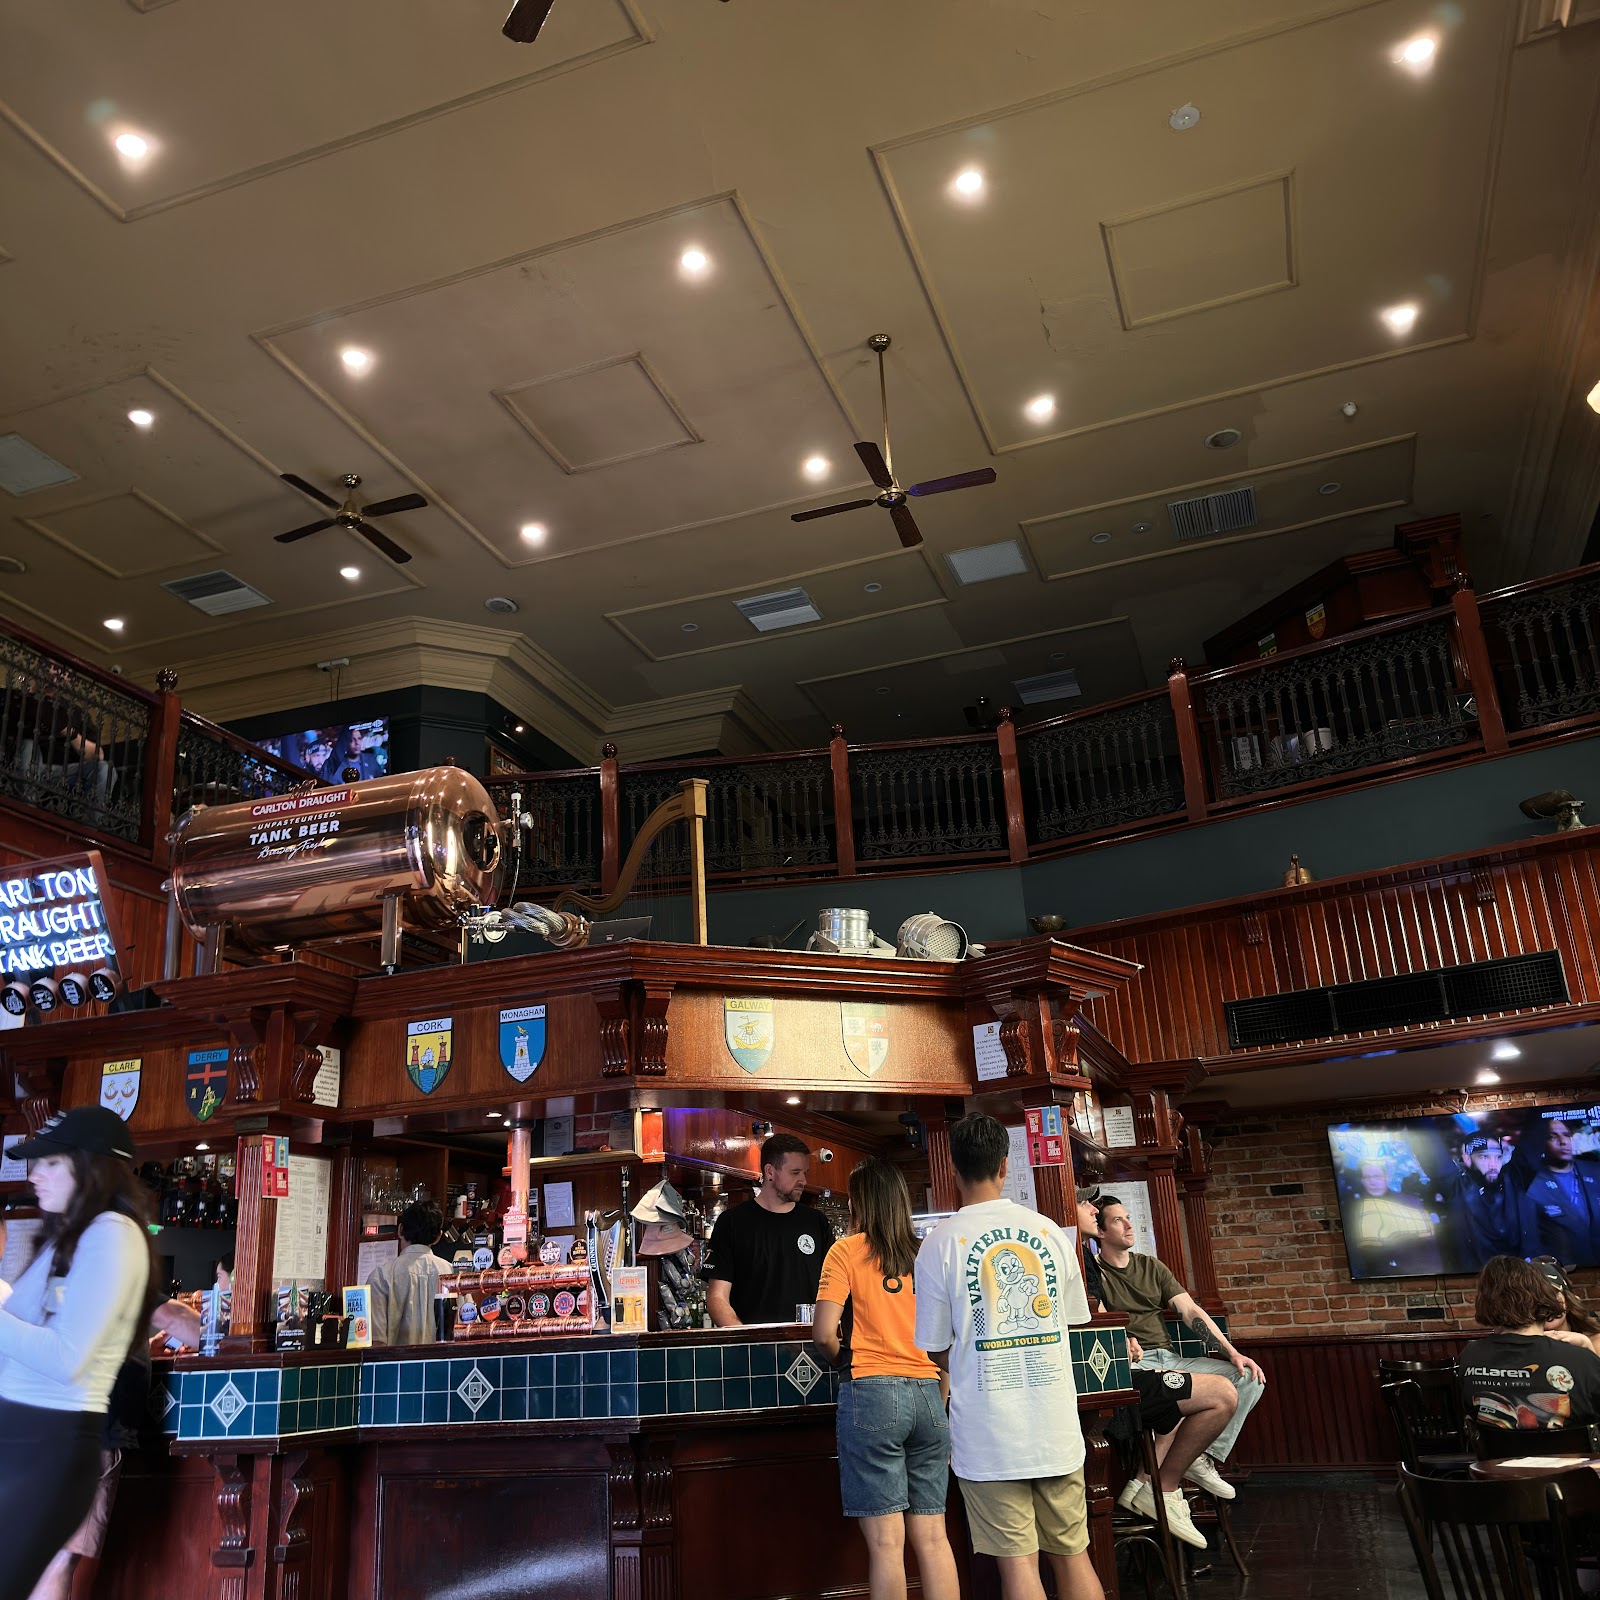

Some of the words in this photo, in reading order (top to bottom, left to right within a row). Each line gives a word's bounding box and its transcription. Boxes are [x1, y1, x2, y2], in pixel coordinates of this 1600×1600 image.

[252, 800, 297, 816] CARLTON
[299, 791, 348, 808] DRAUGHT
[249, 827, 292, 846] TANK
[298, 820, 340, 838] BEER
[51, 933, 116, 966] BEER
[730, 1000, 770, 1010] GALWAY
[501, 1008, 545, 1020] MONAGHAN
[417, 1020, 443, 1032] CORK
[195, 1052, 223, 1062] DERRY
[108, 1062, 136, 1072] CLARE
[540, 1251, 560, 1261] DRY
[966, 1228, 1012, 1306] VALTTERI
[1016, 1229, 1057, 1298] BOTTAS
[482, 1303, 498, 1314] GOAT
[982, 1340, 1013, 1350] WORLD
[1013, 1336, 1040, 1346] TOUR
[1464, 1366, 1531, 1378] McLaren
